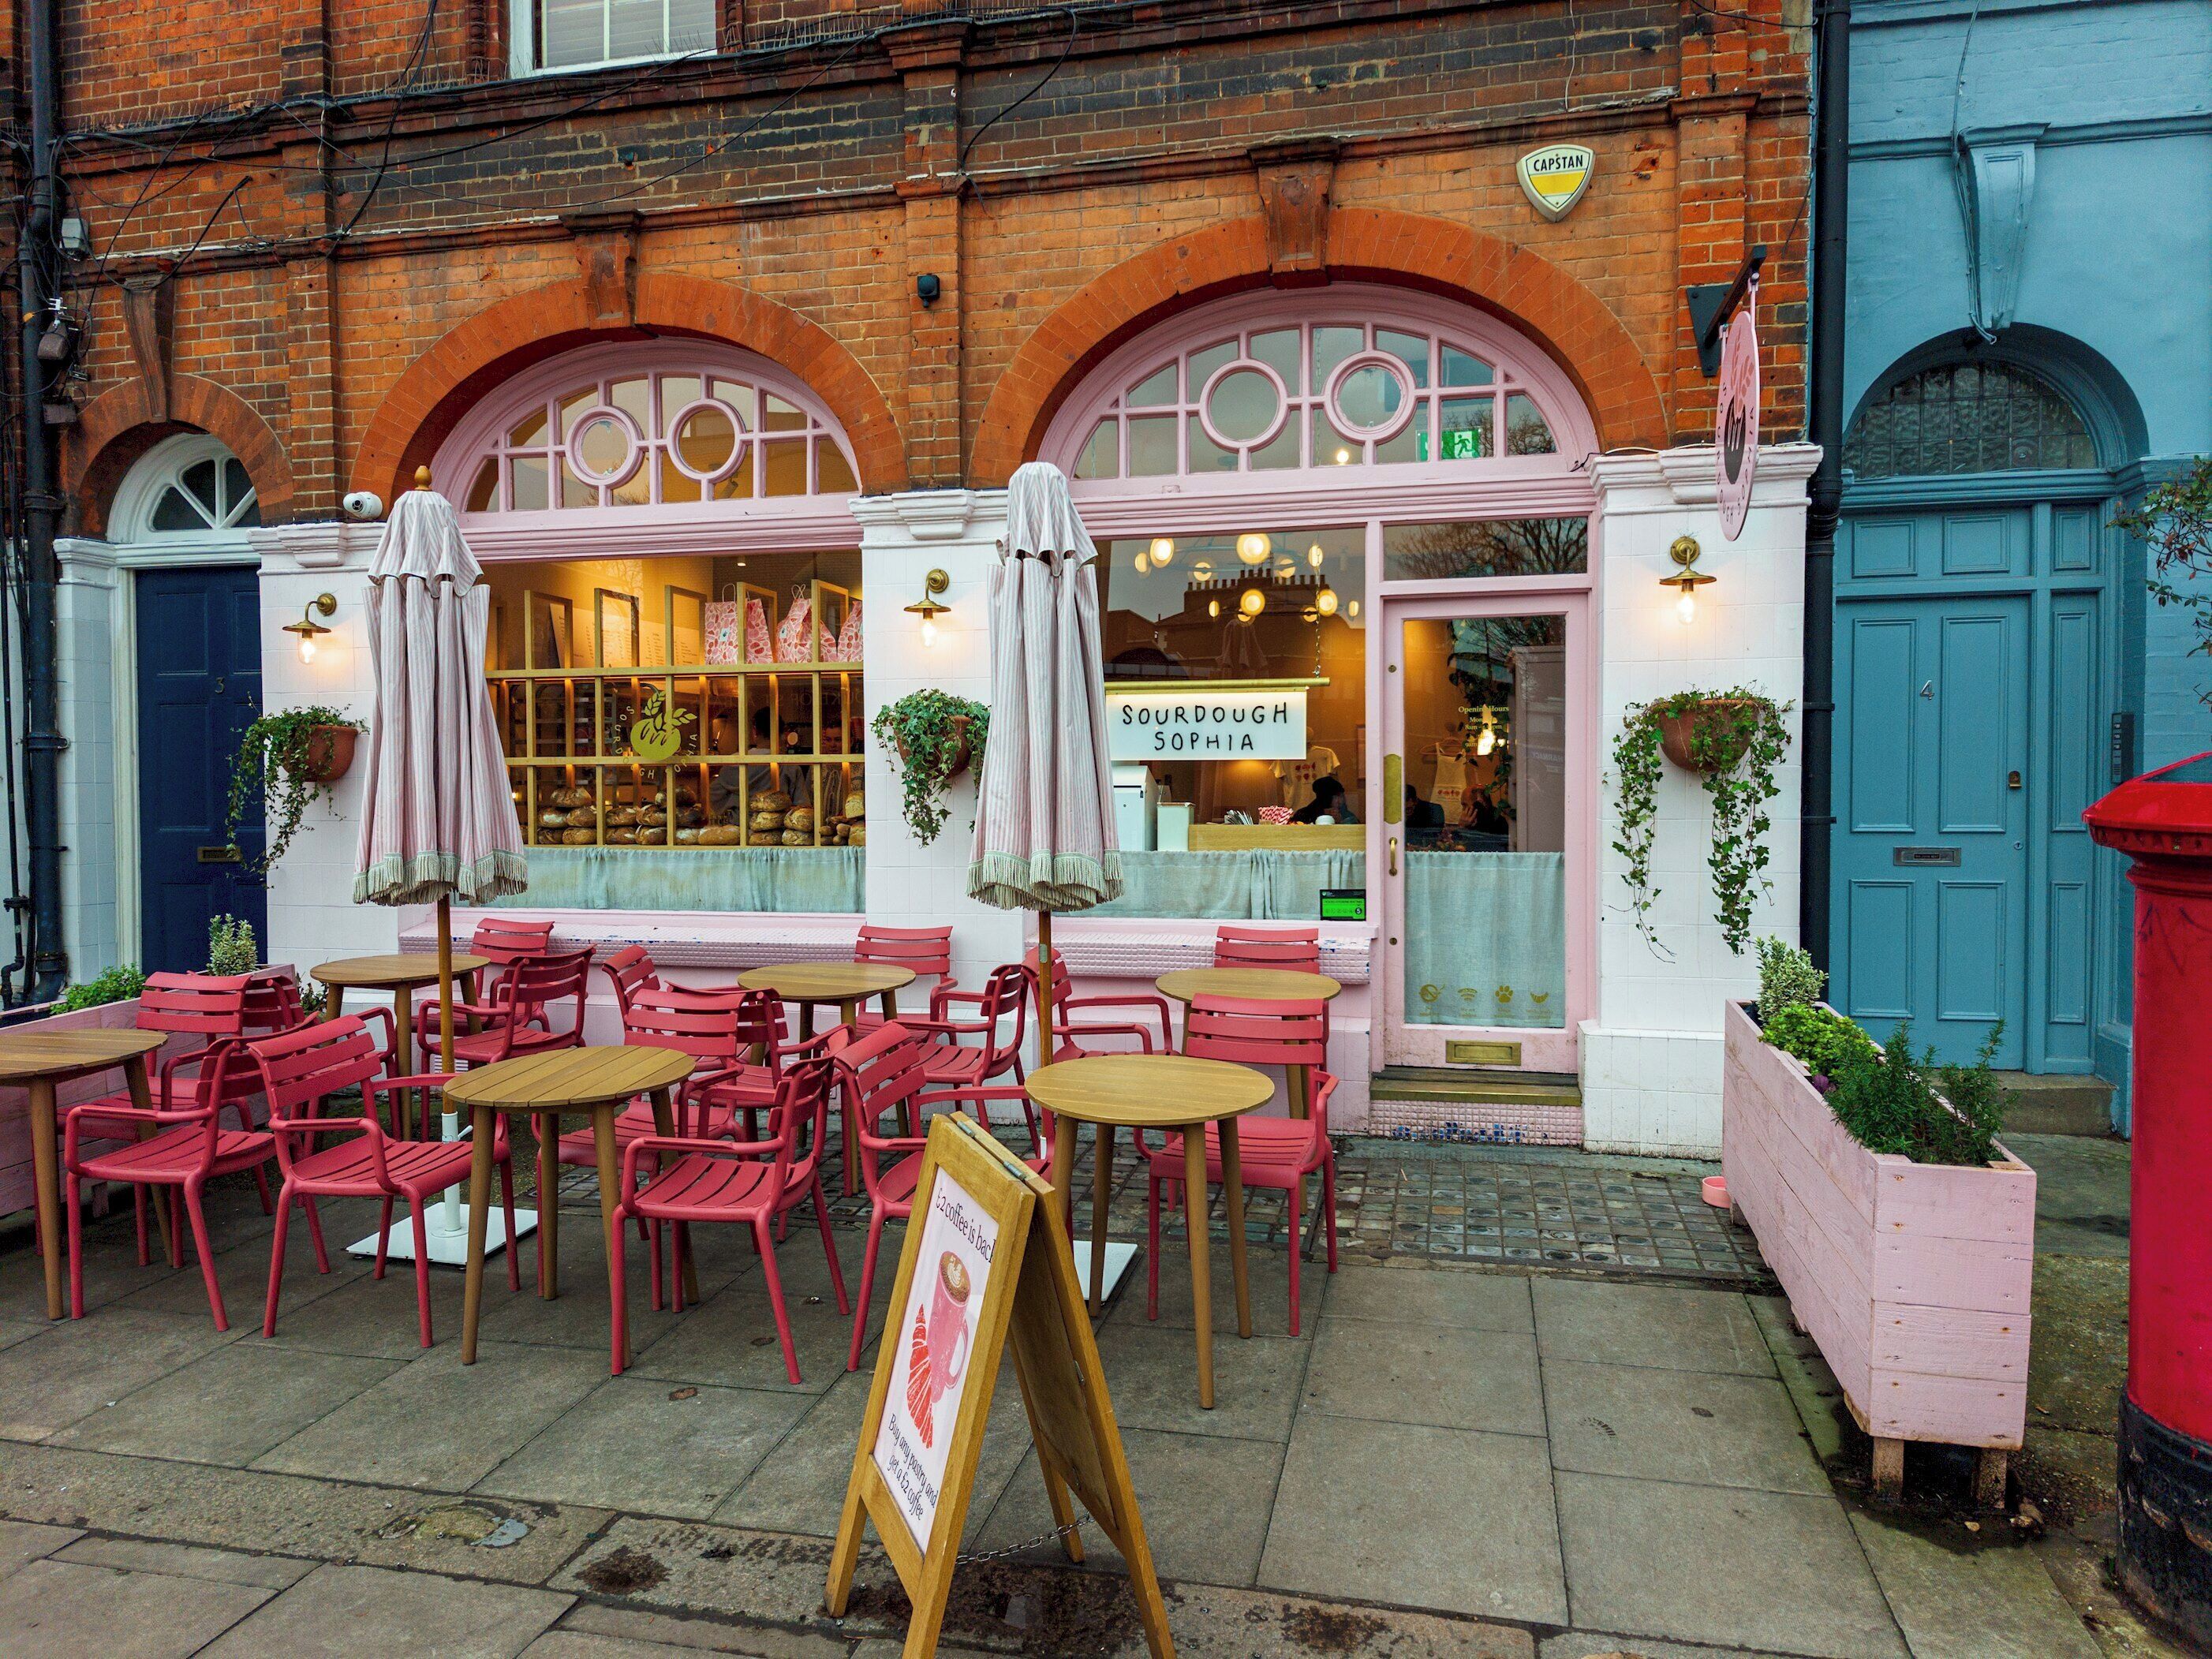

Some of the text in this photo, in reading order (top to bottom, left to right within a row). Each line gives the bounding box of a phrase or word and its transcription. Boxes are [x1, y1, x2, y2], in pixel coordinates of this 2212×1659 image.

[1534, 155, 1583, 172] CAPSTAN
[215, 677, 224, 694] 3
[1122, 701, 1287, 725] SOURDOUGH
[1458, 706, 1486, 715] Openin
[1154, 731, 1254, 751] SOPHIA
[936, 1188, 946, 1212] £2
[945, 1203, 969, 1236] coffee
[968, 1218, 976, 1244] is
[888, 1413, 939, 1508] Buy any pastry and
[887, 1455, 924, 1521] get a £2 coffee
